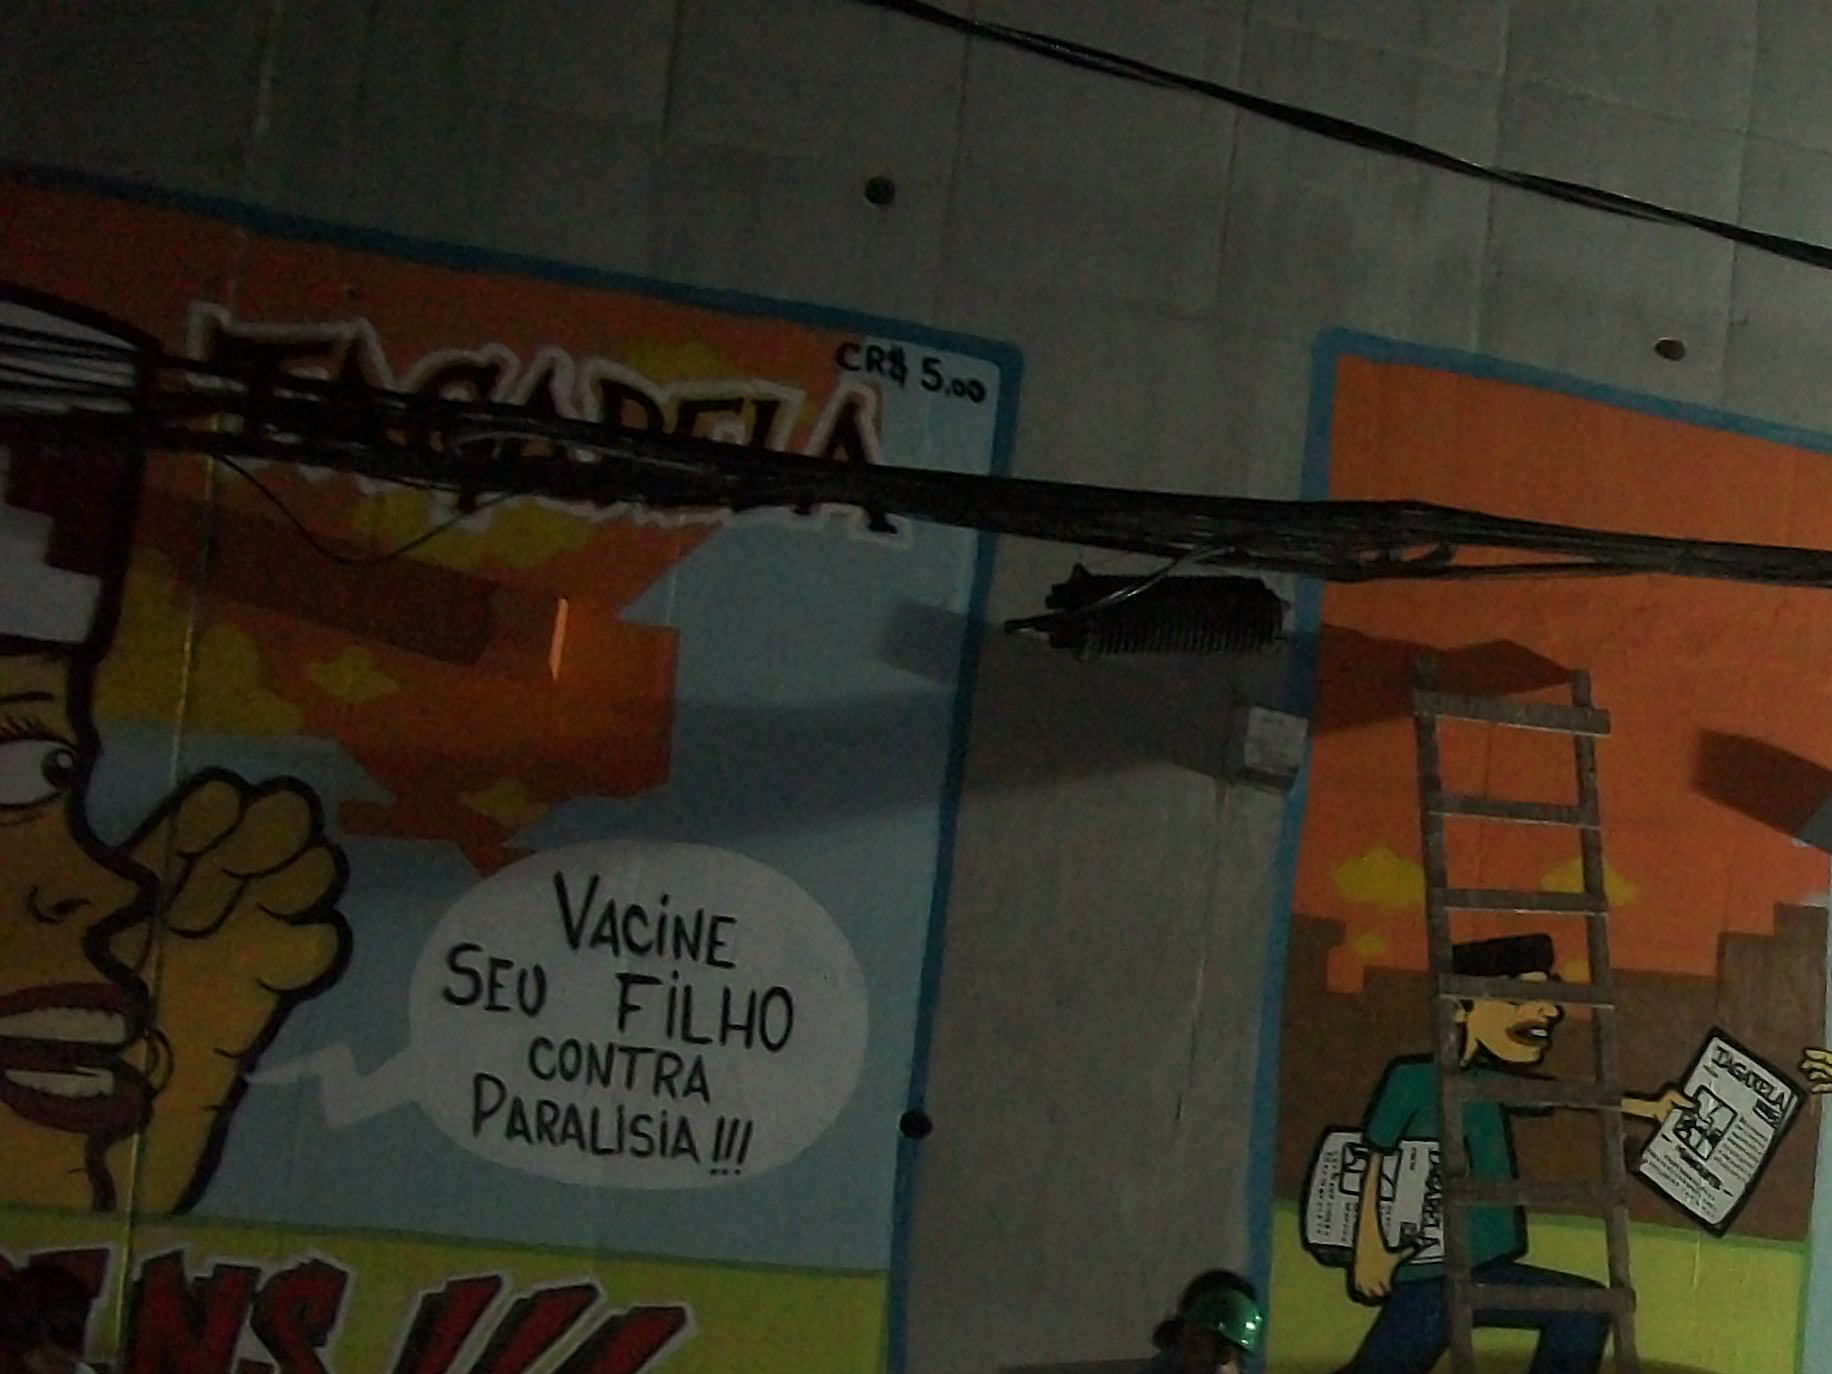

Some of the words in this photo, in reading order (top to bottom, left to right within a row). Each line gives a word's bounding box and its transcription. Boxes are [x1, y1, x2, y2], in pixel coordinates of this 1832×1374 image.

[553, 871, 737, 969] VACINE
[443, 943, 547, 1017] SEU
[616, 971, 794, 1053] FILHO
[528, 1036, 711, 1102] CONTRA
